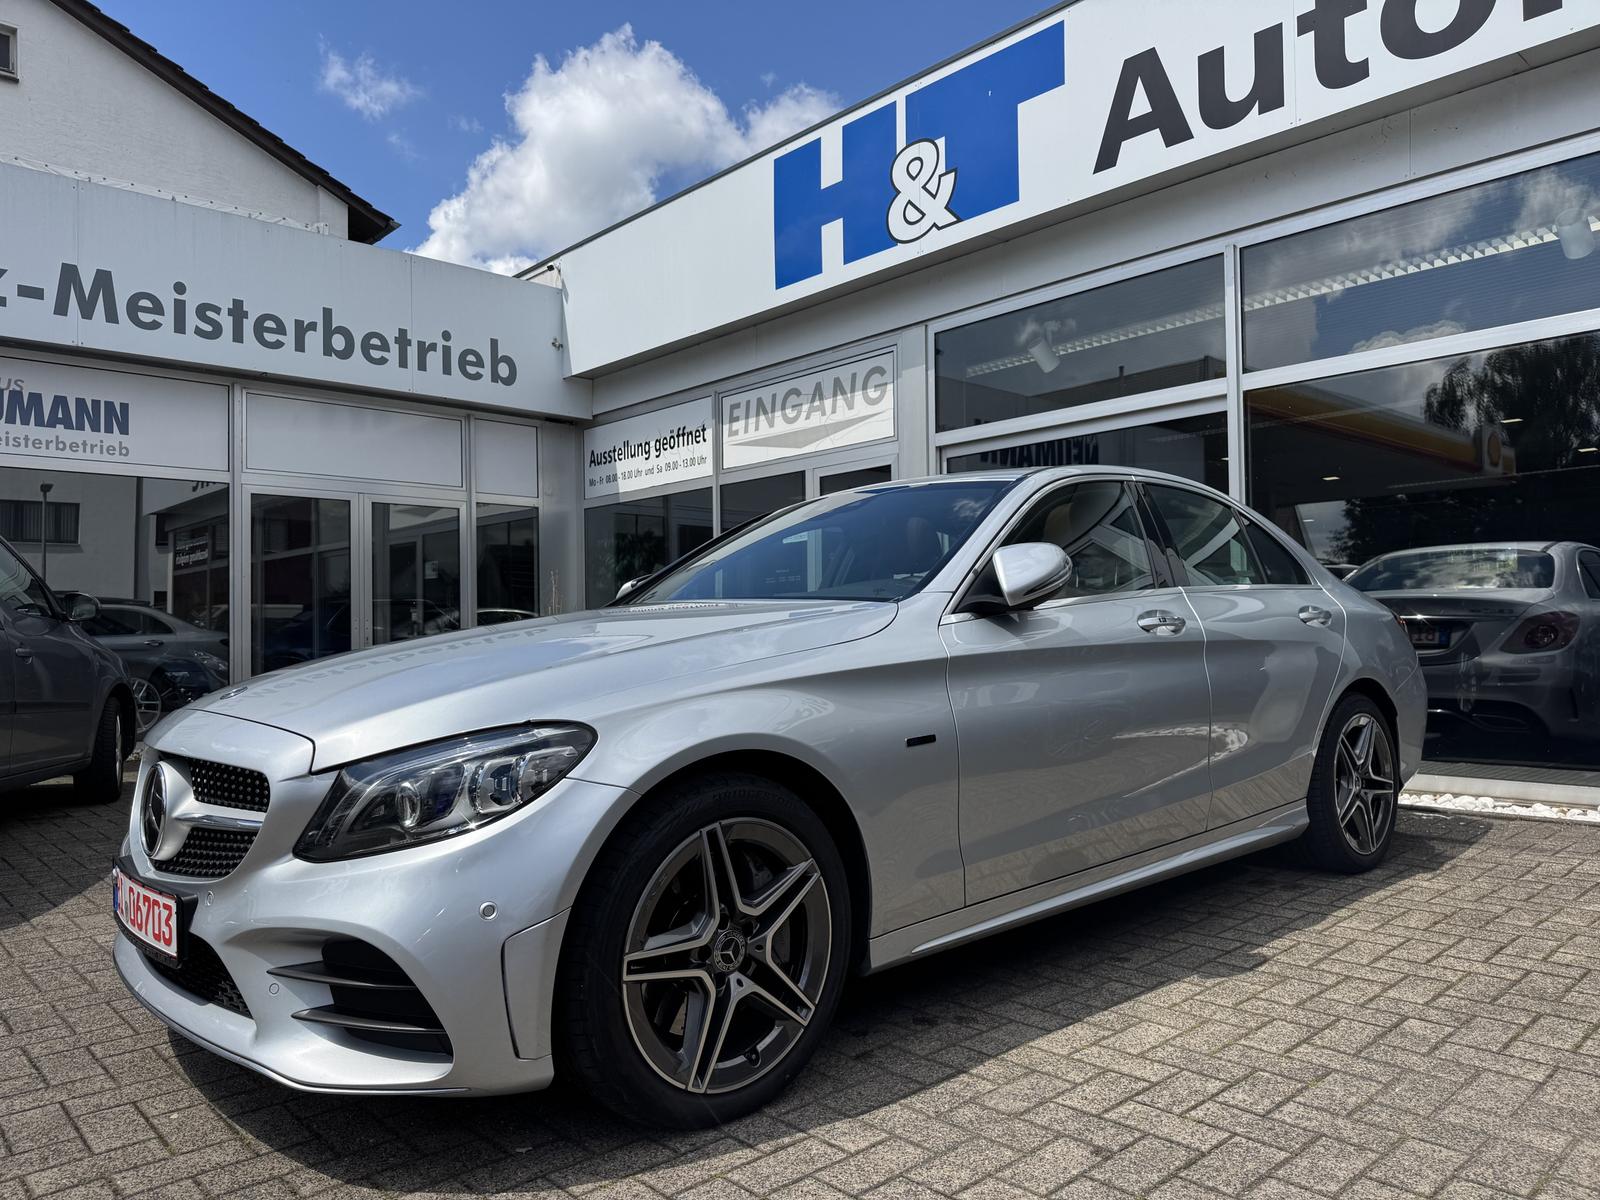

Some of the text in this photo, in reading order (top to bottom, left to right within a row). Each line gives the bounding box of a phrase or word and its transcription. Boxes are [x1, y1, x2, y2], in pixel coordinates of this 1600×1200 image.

[773, 0, 1563, 290] H&T Auto
[0, 389, 129, 436] MANN
[727, 365, 888, 438] EINGANG
[0, 431, 129, 457] isterbetrieb
[589, 424, 707, 468] Ausstellung geöffnet
[605, 472, 618, 484] 08.00
[621, 469, 634, 480] 18.00
[634, 467, 643, 478] Uhr
[644, 464, 654, 476] und
[656, 463, 663, 474] Sa
[665, 459, 678, 472] 09.00
[682, 456, 696, 468] 13.00
[697, 454, 707, 465] Uhr
[128, 886, 173, 946] 06703
